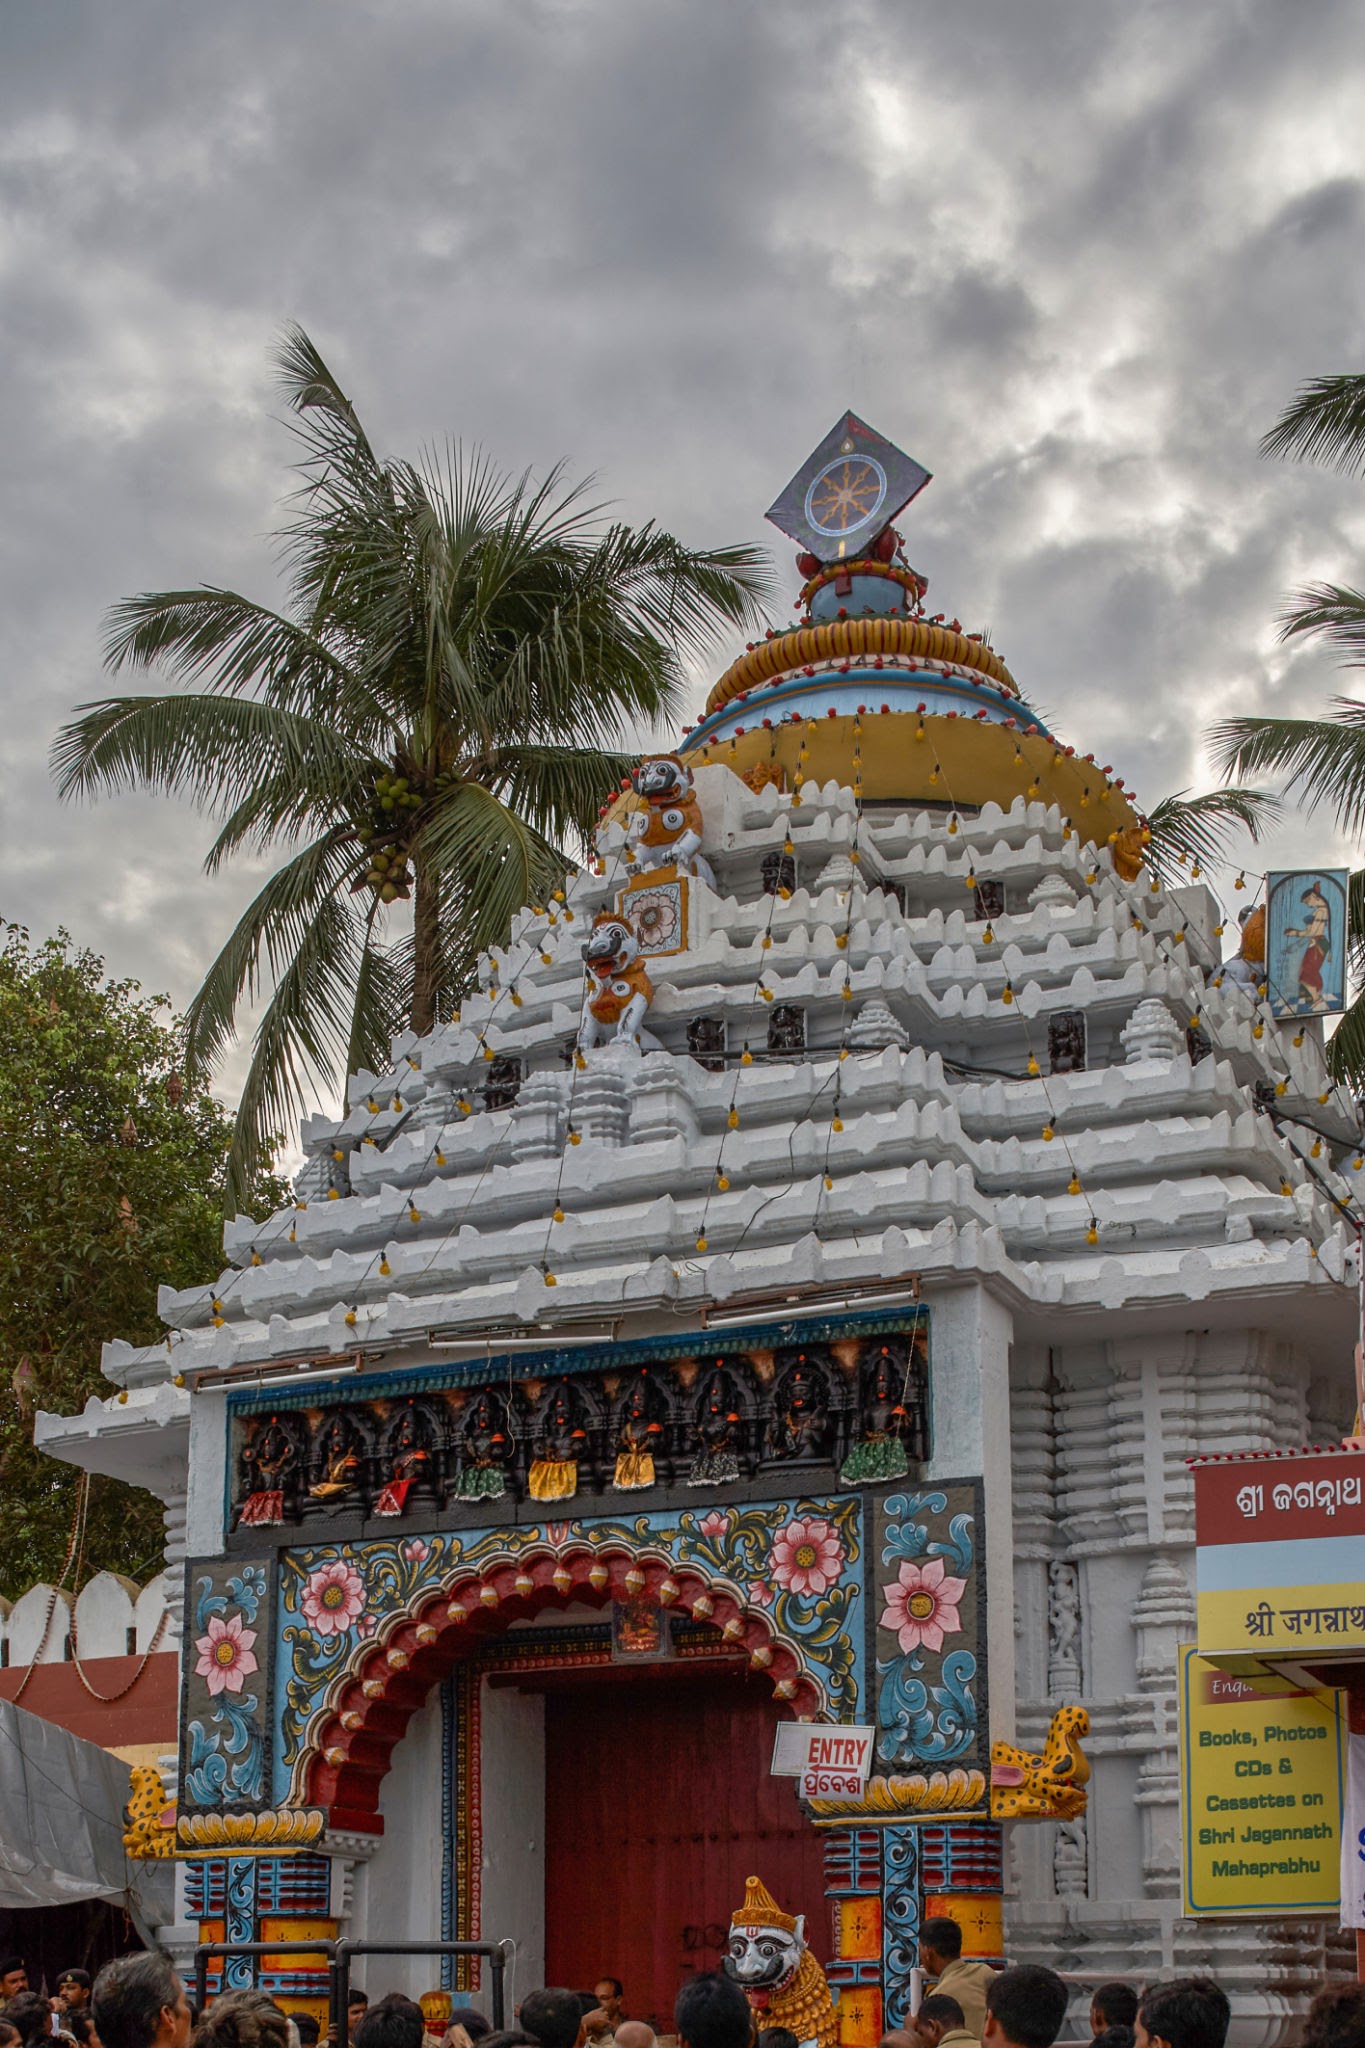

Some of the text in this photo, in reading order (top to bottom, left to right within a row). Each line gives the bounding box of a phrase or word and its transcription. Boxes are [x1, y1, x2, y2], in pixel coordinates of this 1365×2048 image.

[1236, 1477, 1362, 1517] ଶ୍ରୀ ଜଗନ୍ନାଥ
[1245, 1602, 1365, 1636] श्री जगन्नाथ
[1212, 1679, 1254, 1697] Enqu
[1199, 1725, 1328, 1748] Books, Photos
[808, 1737, 869, 1766] ENTRY
[1235, 1758, 1293, 1777] CDs &
[804, 1773, 861, 1796] ପ୍ରବେଶ
[1206, 1793, 1324, 1812] Cassettes on
[1199, 1823, 1333, 1845] Shri Jagannath
[1212, 1857, 1321, 1878] Mahaprabhu
